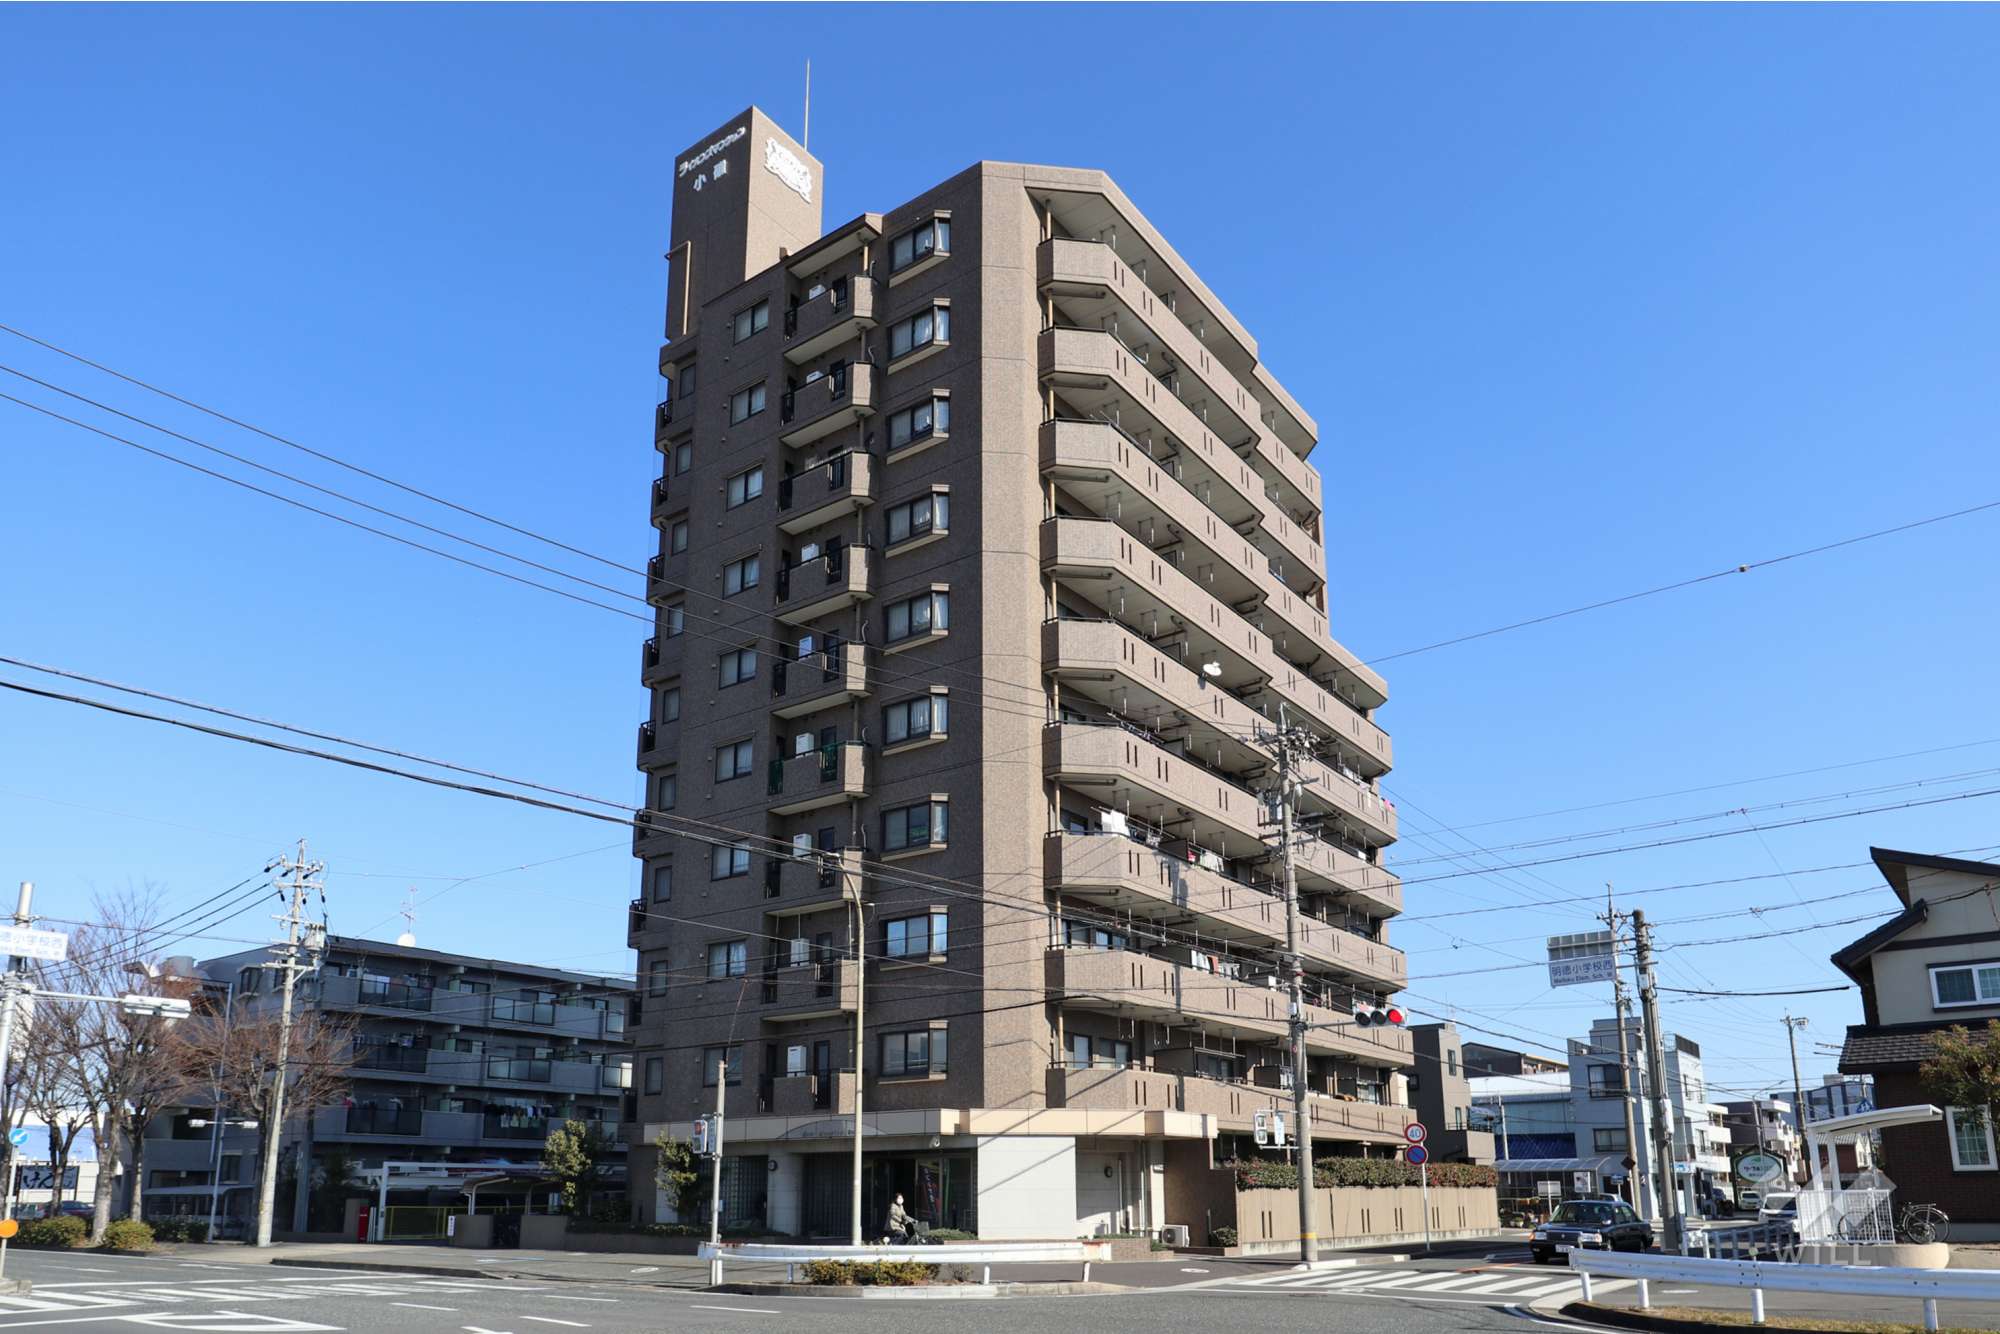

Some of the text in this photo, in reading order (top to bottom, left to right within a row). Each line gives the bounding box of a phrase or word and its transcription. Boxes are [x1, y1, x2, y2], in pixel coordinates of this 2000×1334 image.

[1551, 959, 1613, 977] 明徳小学校西
[1410, 1127, 1422, 1138] 40
